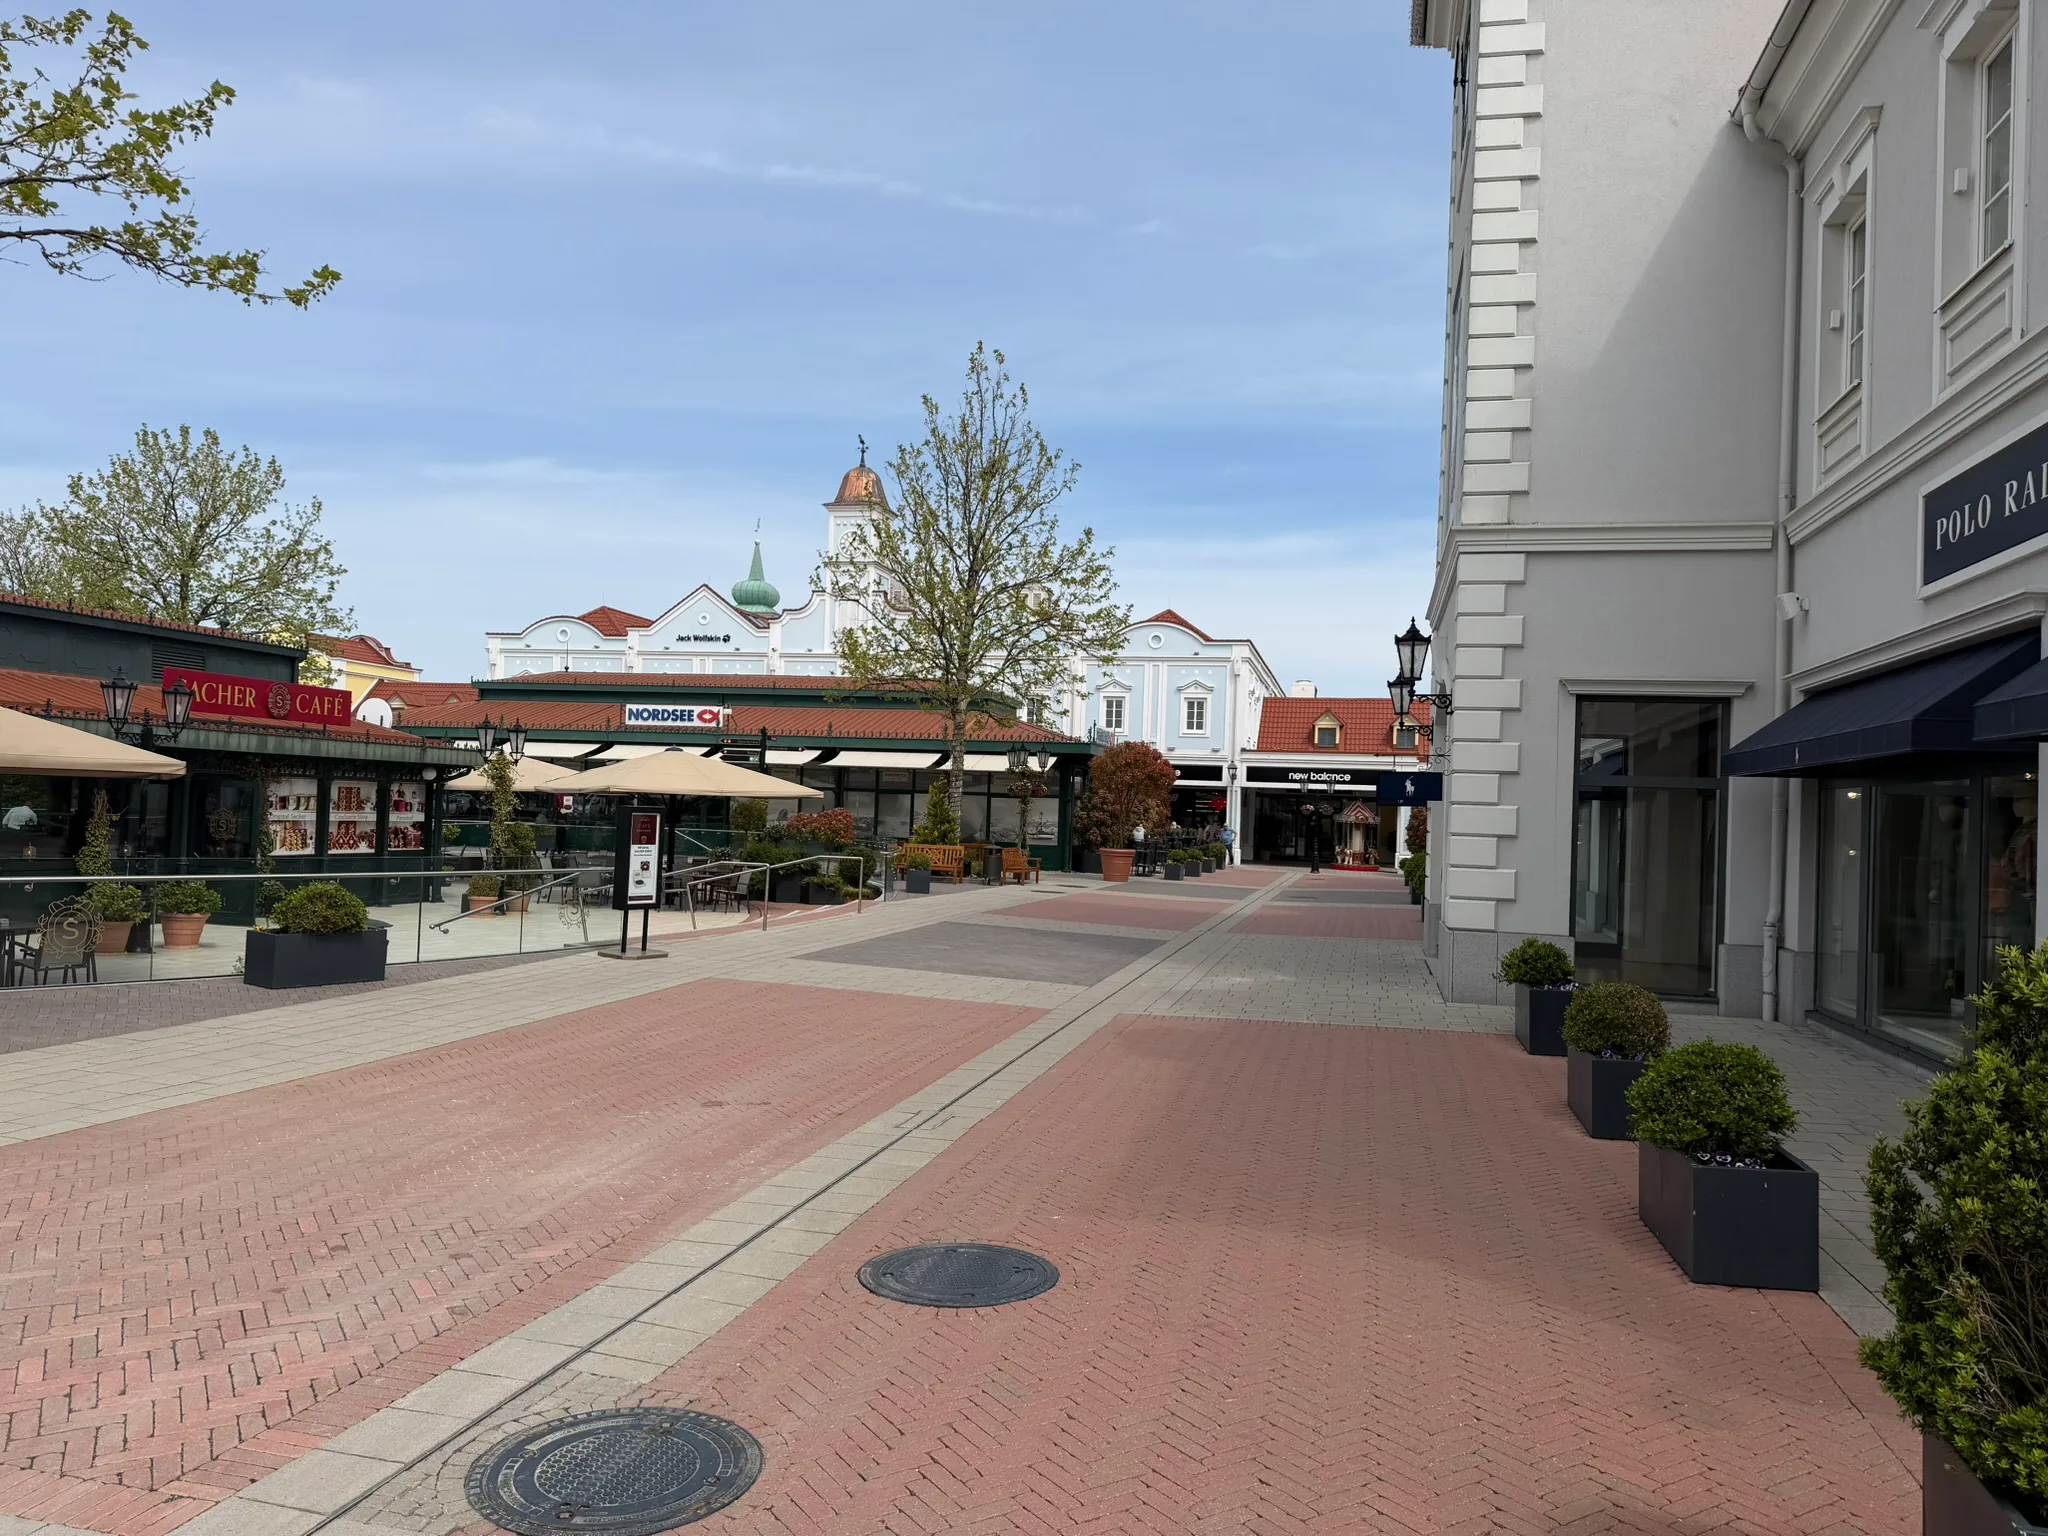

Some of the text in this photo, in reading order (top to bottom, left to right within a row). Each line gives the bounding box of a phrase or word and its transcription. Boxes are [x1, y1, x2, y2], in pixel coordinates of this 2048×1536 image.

[1935, 494, 1992, 550] POLO
[676, 634, 721, 642] Jack Wolfskin
[180, 679, 343, 717] ACHER S CAFÉ
[628, 707, 695, 722] NORDSEE
[1288, 771, 1351, 781] new balance
[218, 819, 227, 831] S
